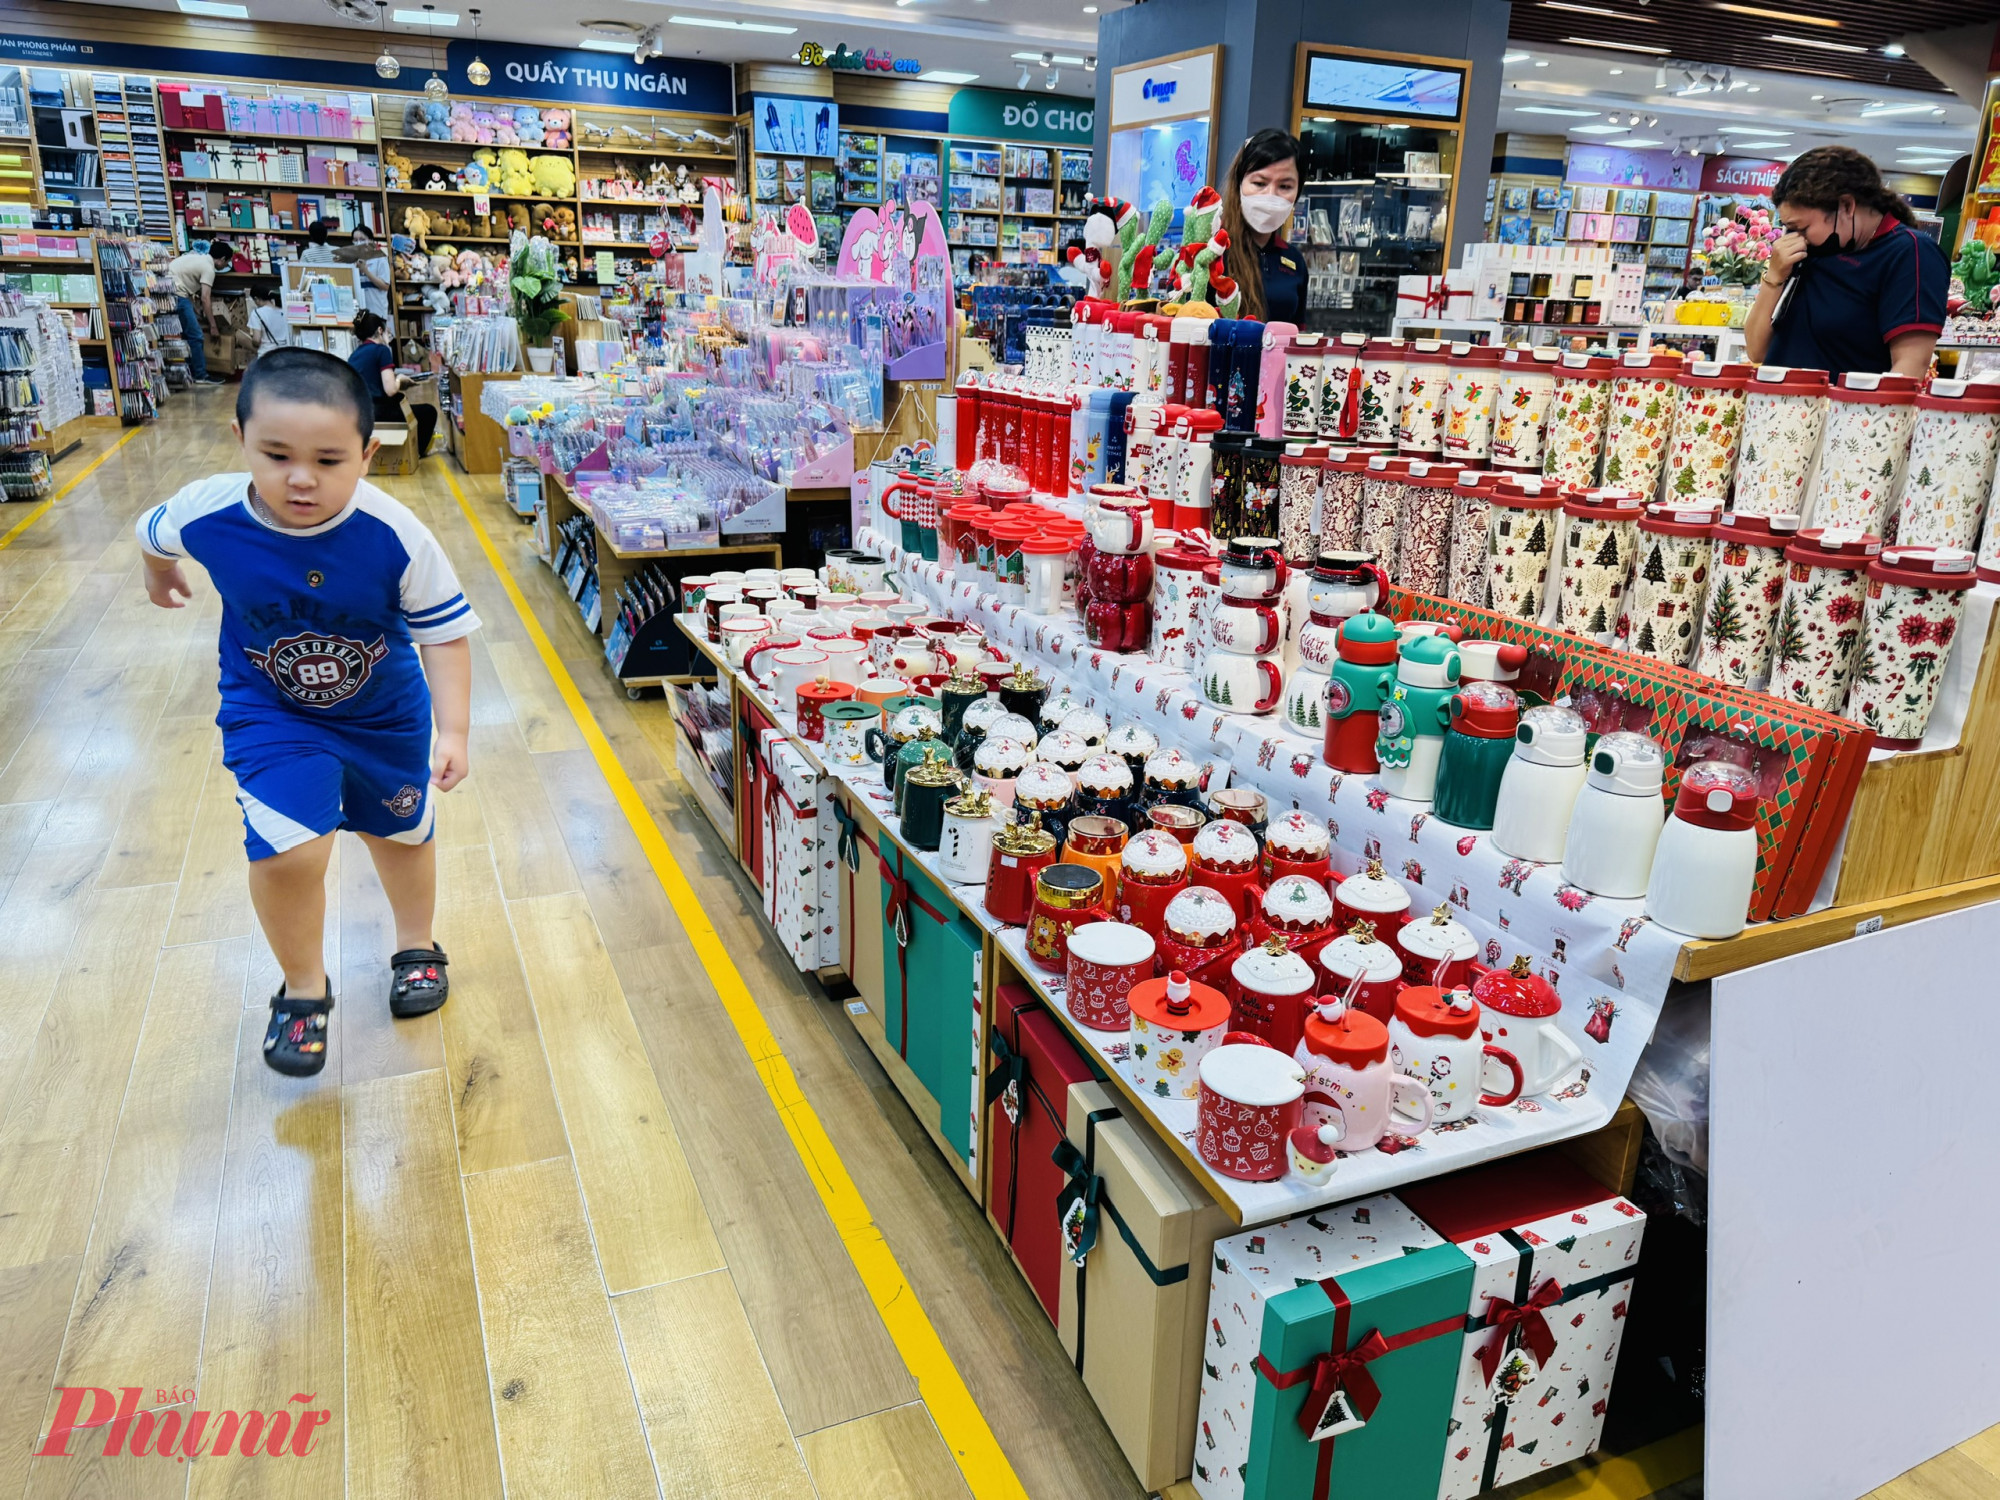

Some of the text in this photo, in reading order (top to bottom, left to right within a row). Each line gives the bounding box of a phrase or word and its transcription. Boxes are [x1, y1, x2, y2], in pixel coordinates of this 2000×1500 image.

[800, 42, 826, 66] Đồ
[865, 48, 893, 71] trẻ
[894, 58, 921, 73] em
[505, 60, 687, 95] QUẦY THU NGÂN
[1152, 80, 1177, 97] PILOT
[1003, 100, 1039, 128] ĐỒ
[1716, 166, 1748, 185] SÁCH
[297, 661, 340, 685] 89
[291, 678, 356, 699] SAN DIEGO
